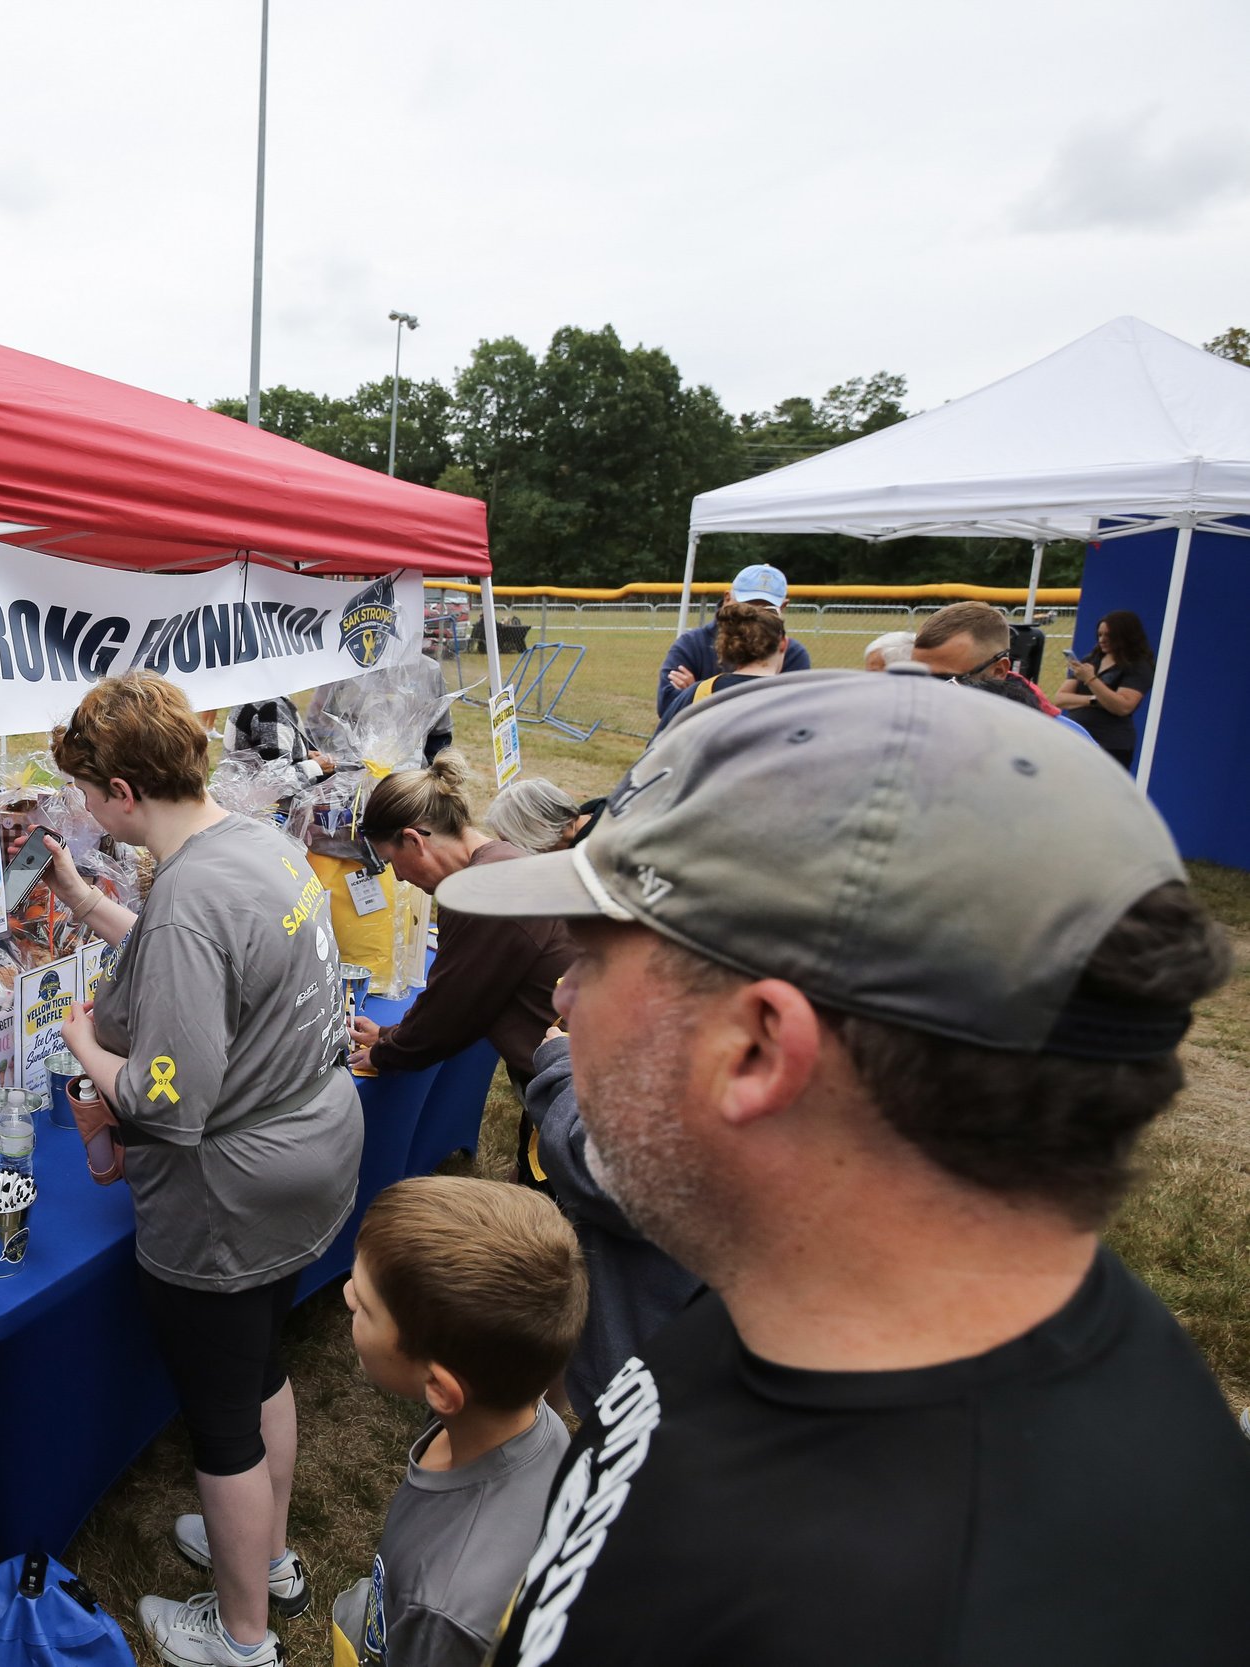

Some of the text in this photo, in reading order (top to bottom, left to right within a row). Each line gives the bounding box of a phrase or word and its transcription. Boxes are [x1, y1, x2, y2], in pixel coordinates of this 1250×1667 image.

[342, 608, 395, 632] SAK STRONG
[130, 601, 332, 676] FOUNDATION
[282, 898, 310, 936] SAK
[302, 874, 324, 908] STRO
[27, 996, 72, 1022] YELLOW TICKET
[36, 1009, 62, 1028] RAFFLE
[0, 1016, 14, 1031] BETT
[0, 1034, 10, 1052] ICE
[34, 1028, 62, 1050] Ice Crea
[26, 1047, 50, 1069] Sundae
